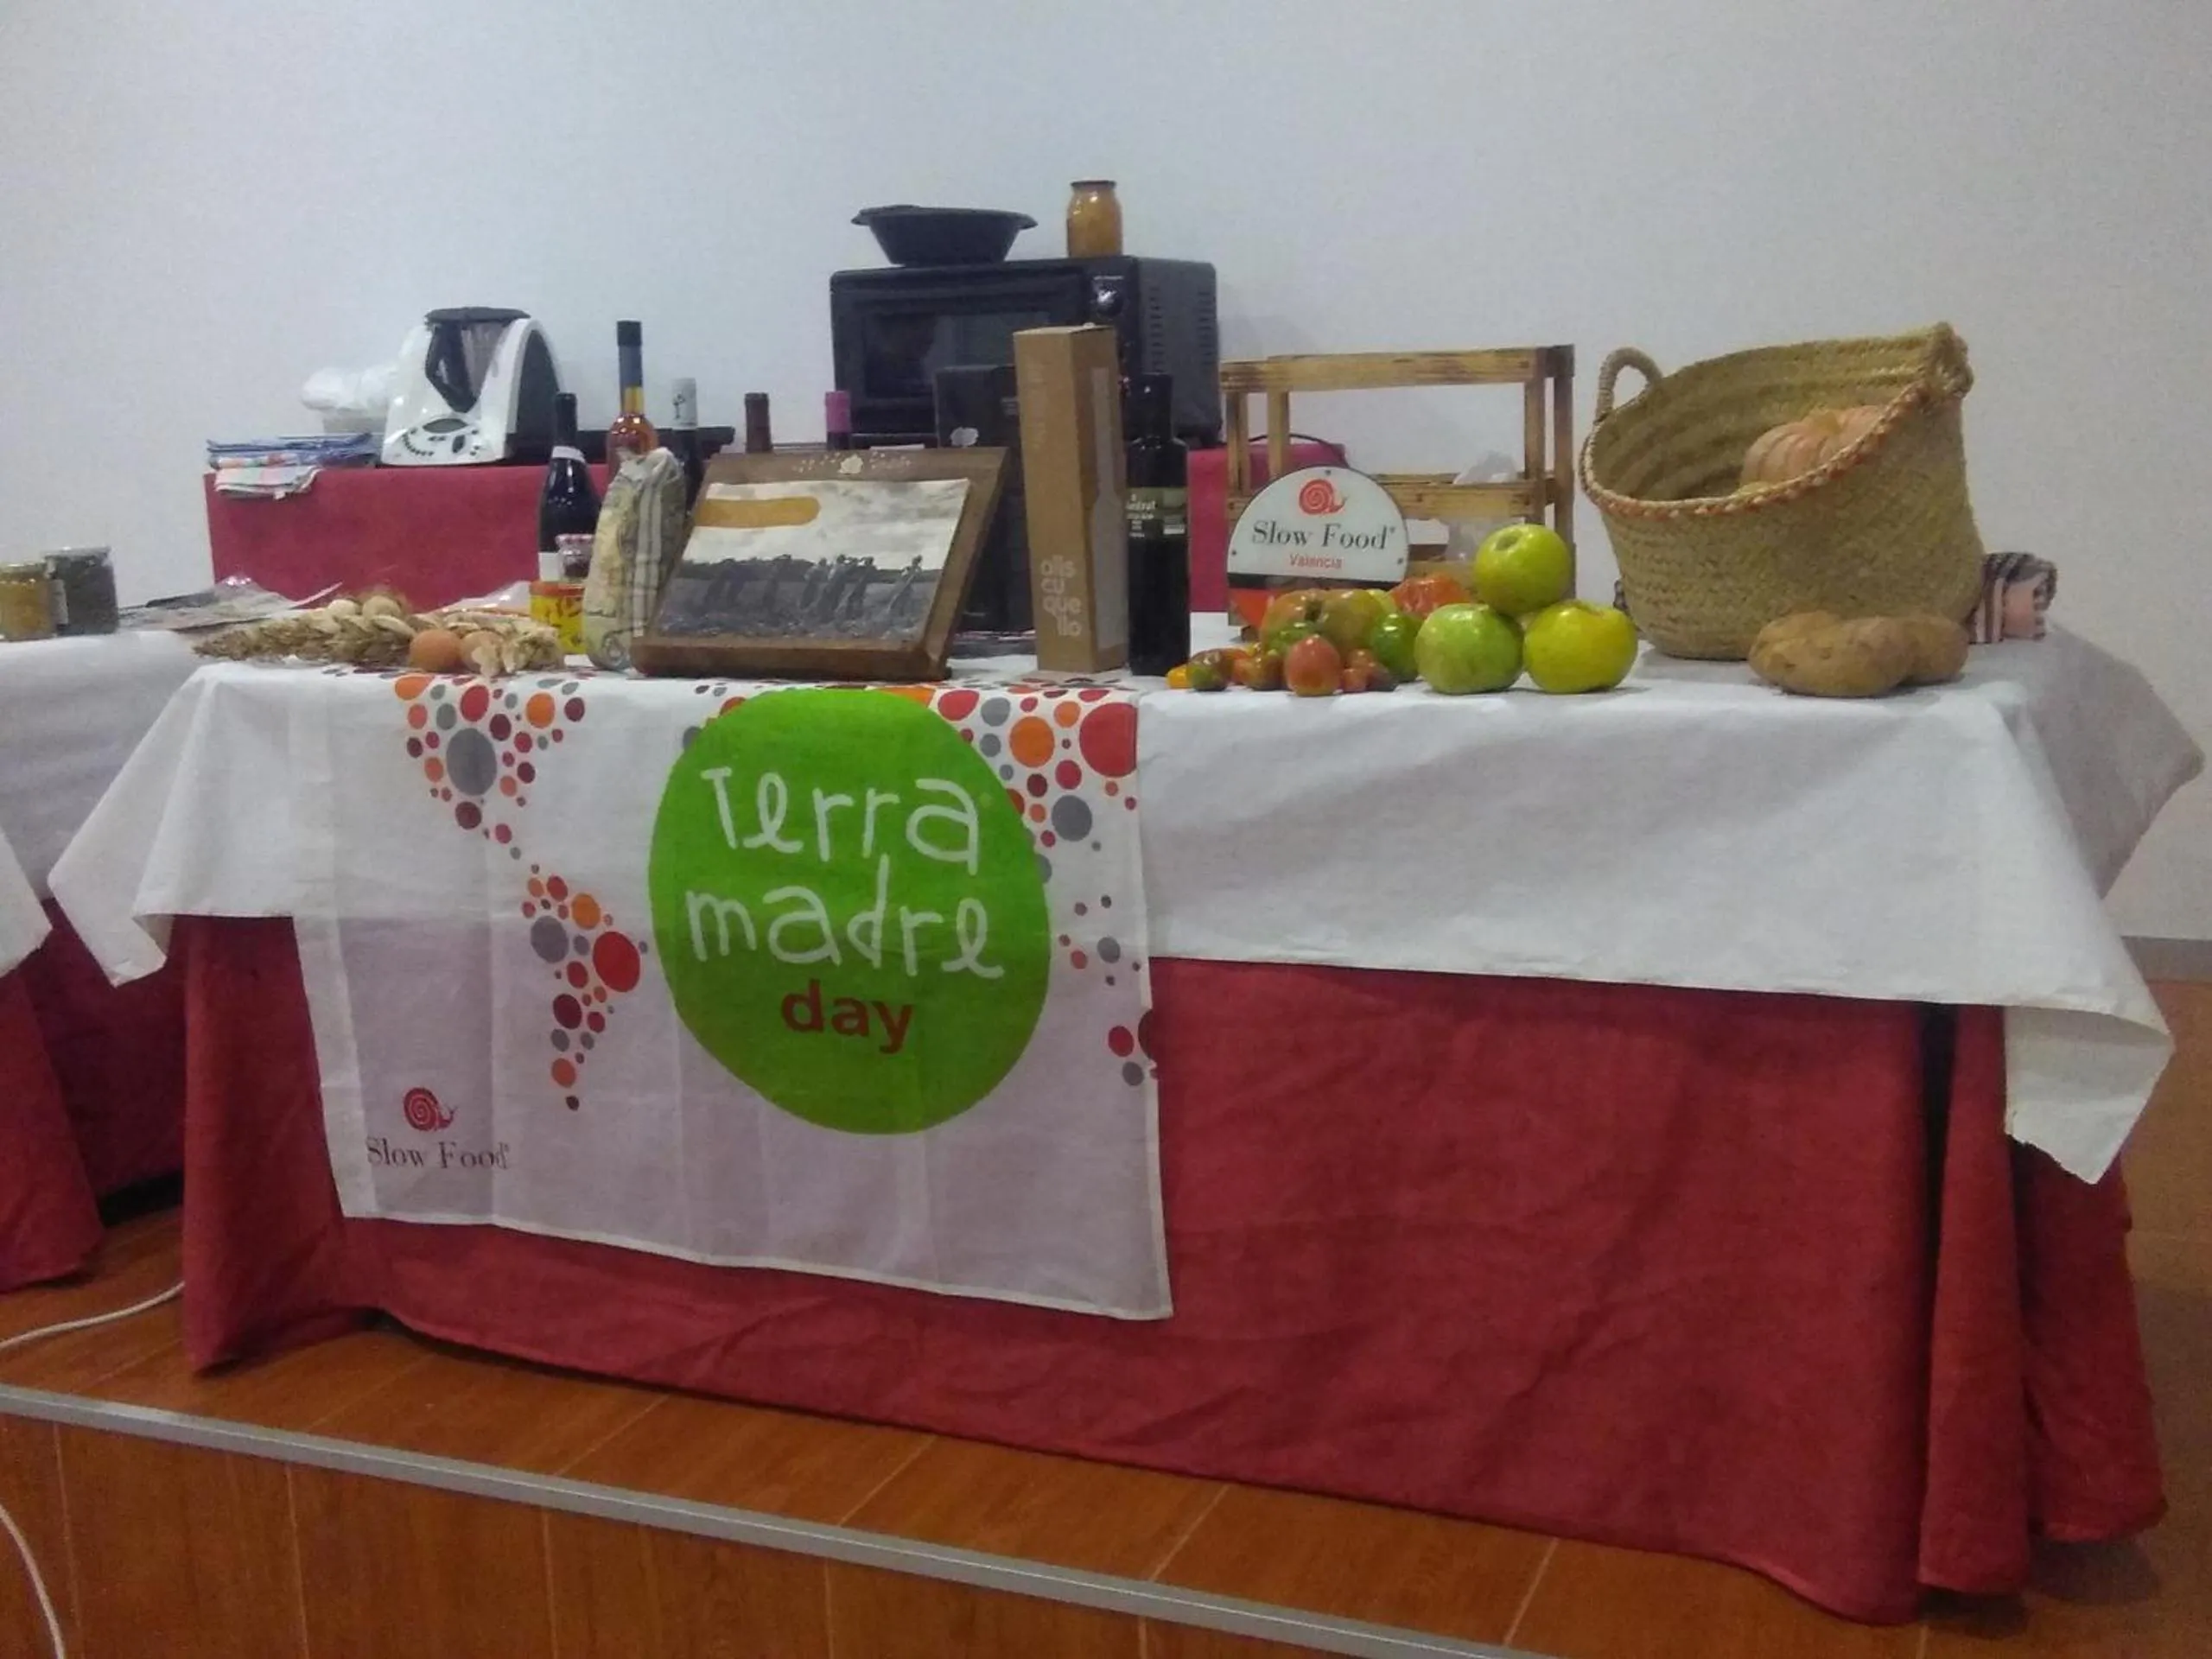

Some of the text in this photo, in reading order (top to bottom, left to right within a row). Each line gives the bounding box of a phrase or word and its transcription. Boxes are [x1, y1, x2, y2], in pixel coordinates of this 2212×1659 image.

[1253, 520, 1312, 546] Slow
[1290, 553, 1343, 569] Valencia
[700, 766, 979, 875] Terra
[685, 854, 1005, 978] madre
[781, 978, 914, 1054] day
[366, 1136, 426, 1166] Slow
